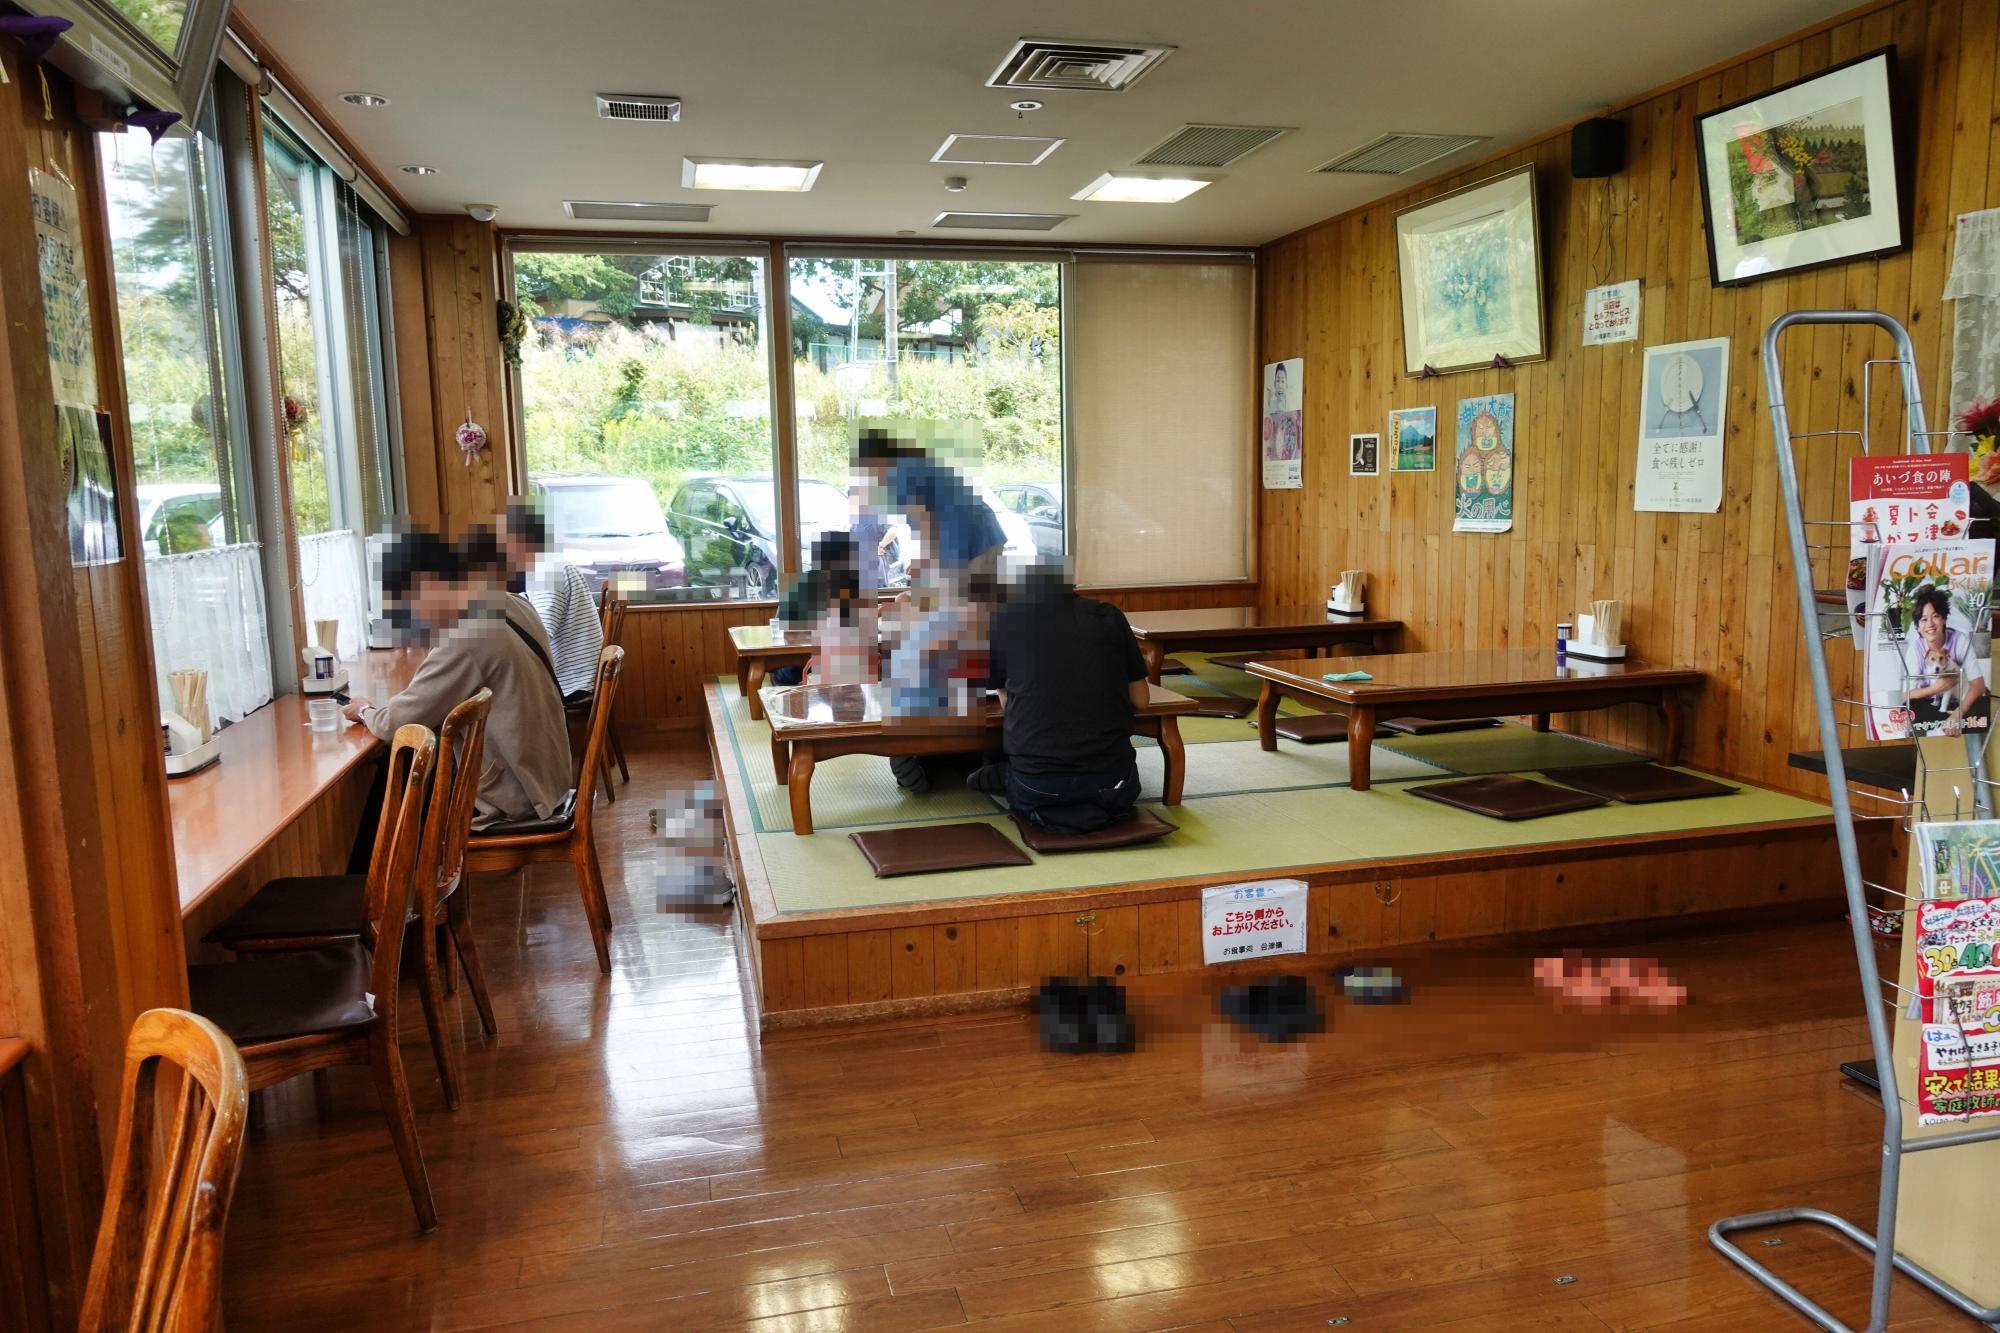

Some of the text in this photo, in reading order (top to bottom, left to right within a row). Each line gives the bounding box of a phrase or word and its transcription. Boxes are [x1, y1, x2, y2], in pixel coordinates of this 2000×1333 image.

[1593, 308, 1631, 321] セルフサービス
[1588, 317, 1632, 331] となっております。
[1652, 457, 1704, 469] 食べ残しゼロ
[1872, 469, 1952, 486] あいづ食の陣
[1455, 493, 1511, 519] 火の用心
[1924, 503, 1940, 541] 会津
[1888, 552, 1989, 581] Collar
[1969, 592, 1986, 608] ¥0
[1234, 887, 1277, 900] お客様へ
[1225, 907, 1285, 923] こちら側から
[1212, 918, 1294, 937] お上がりください。
[1223, 944, 1254, 956] お食事処
[1936, 1040, 2000, 1058] やればできる子
[1924, 1069, 2000, 1097] 安くて結果
